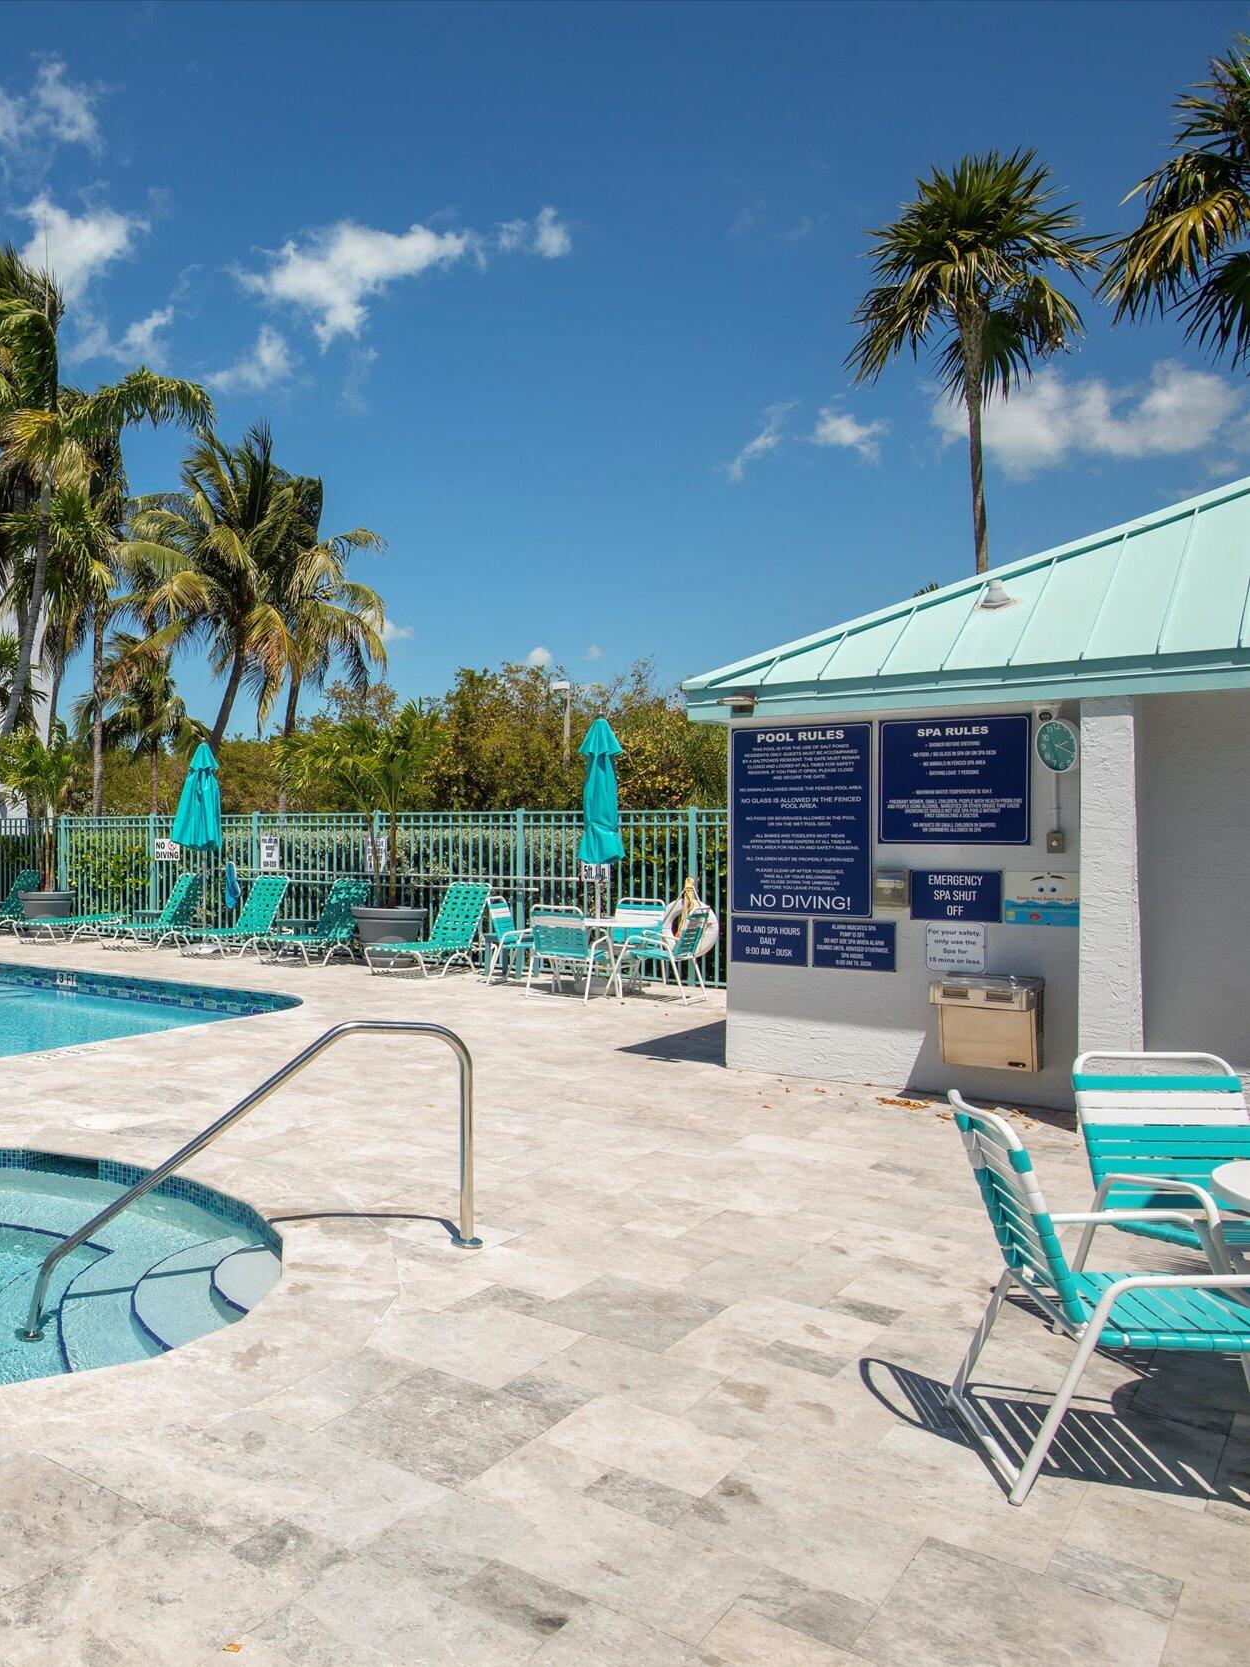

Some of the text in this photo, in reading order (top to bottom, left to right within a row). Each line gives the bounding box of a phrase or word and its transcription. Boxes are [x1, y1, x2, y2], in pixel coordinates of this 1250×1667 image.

[757, 730, 844, 743] POOL RULES
[917, 726, 988, 737] SPA RULES
[928, 875, 983, 886] EMERGENCY
[934, 890, 977, 901] SPA SHUT
[750, 894, 850, 910] NO DIVING!
[947, 906, 964, 916] OFF
[780, 927, 800, 935] HOURS
[776, 949, 792, 957] DUSK
[59, 973, 75, 985] 3 FT
